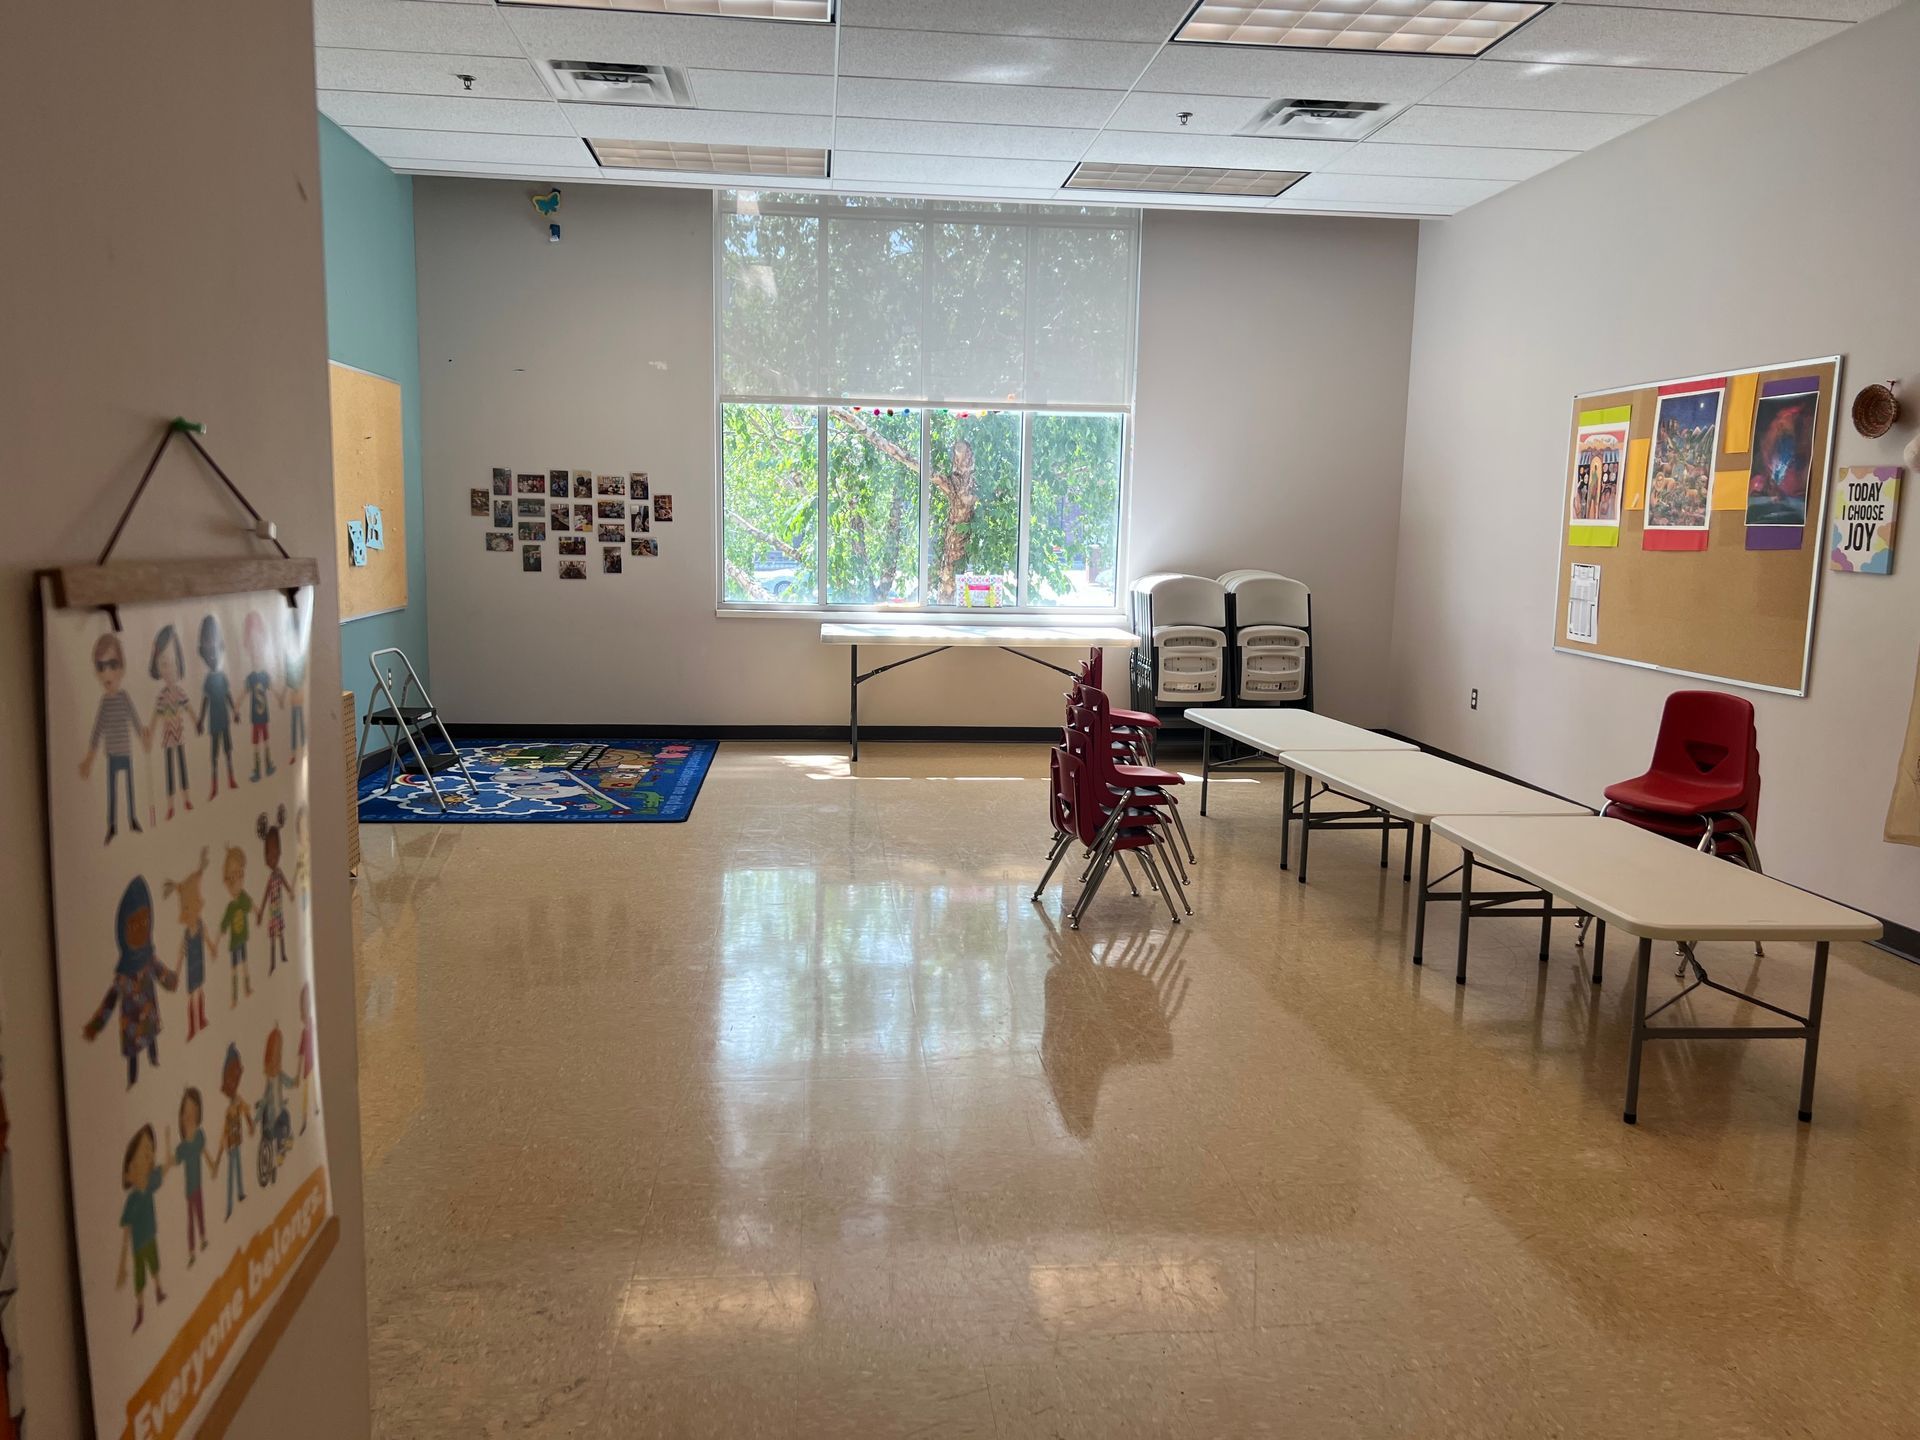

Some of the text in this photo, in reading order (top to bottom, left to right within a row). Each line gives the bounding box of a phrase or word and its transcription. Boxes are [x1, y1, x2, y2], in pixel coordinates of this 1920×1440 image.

[1849, 482, 1883, 501] TODAY
[1842, 505, 1885, 520] I CHOOSE
[1844, 523, 1876, 551] JOY
[134, 1185, 323, 1440] Everyone belongs
